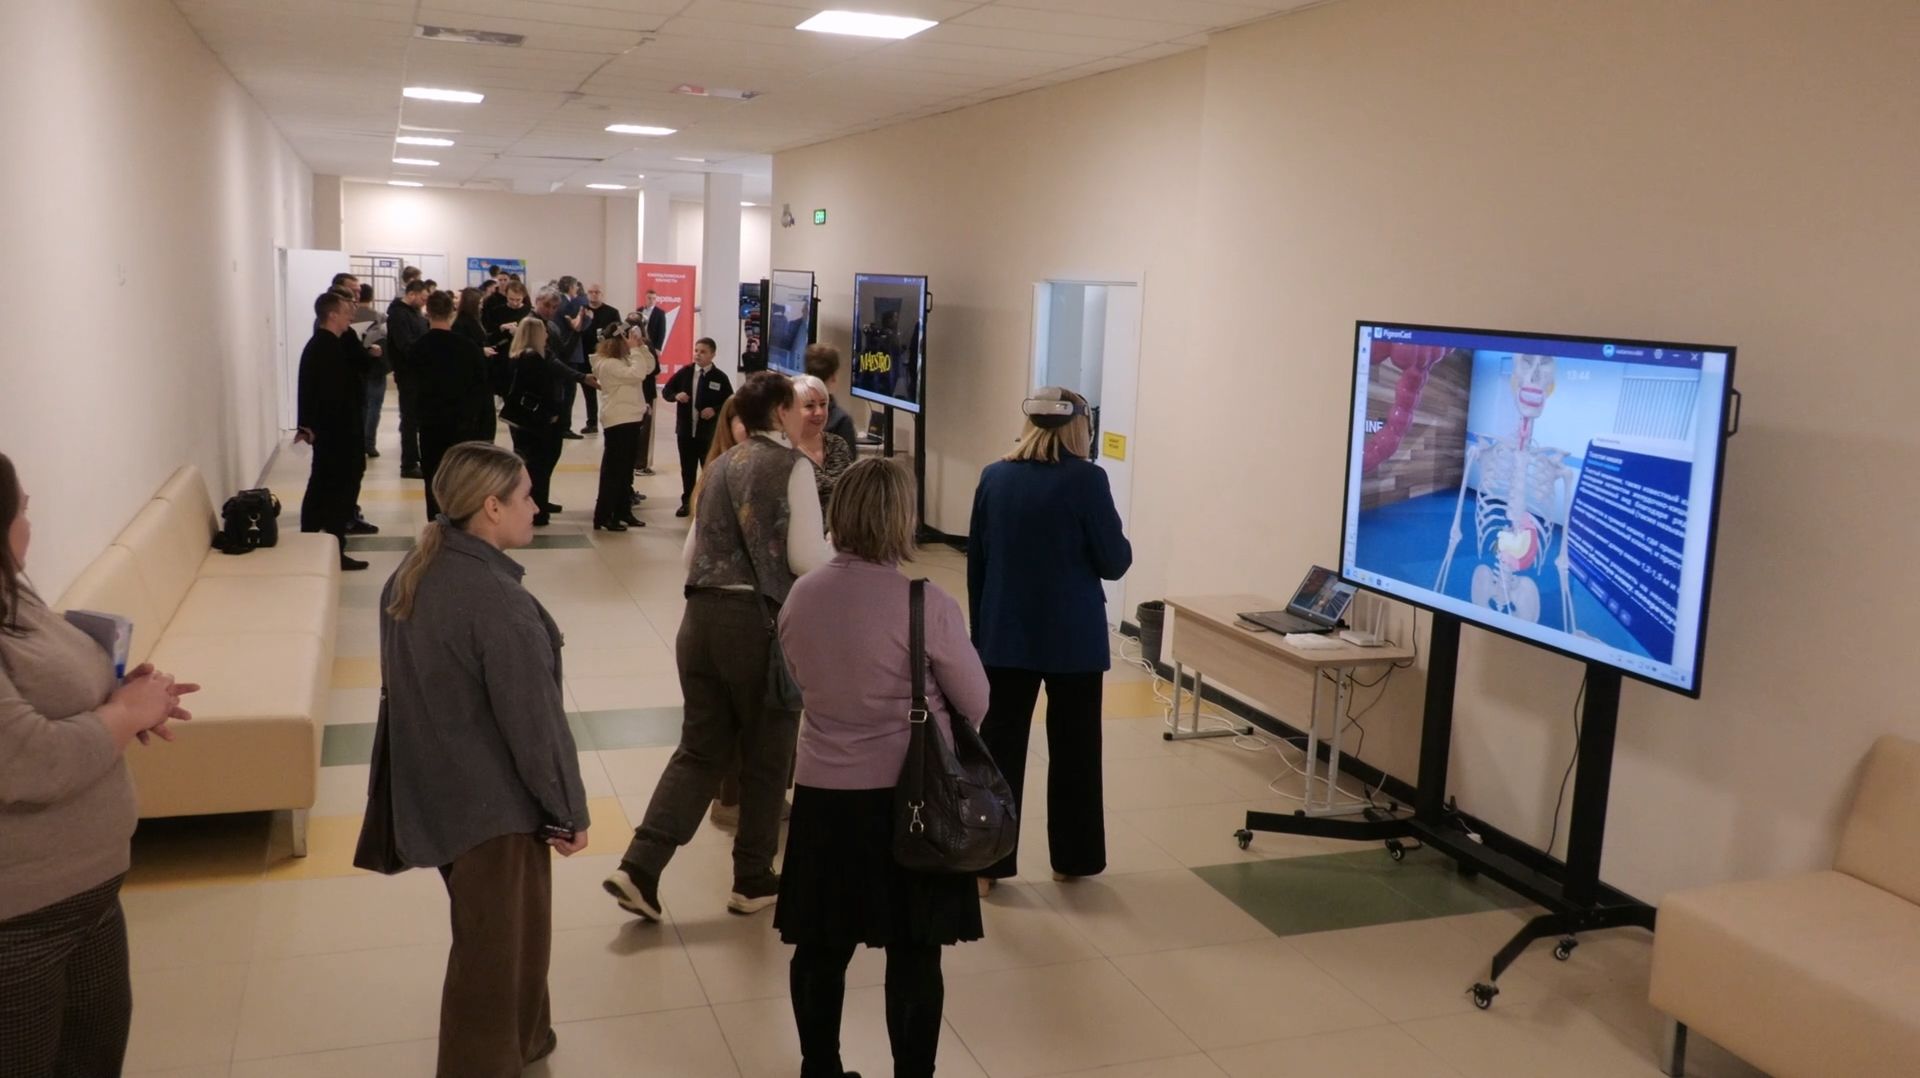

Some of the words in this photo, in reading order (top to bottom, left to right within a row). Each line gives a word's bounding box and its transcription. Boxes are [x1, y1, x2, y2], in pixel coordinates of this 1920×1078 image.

[655, 295, 681, 304] ервые
[1383, 329, 1412, 339] PigeonCast
[859, 351, 892, 373] MAESTRO
[1641, 563, 1662, 582] 1,2-1,5
